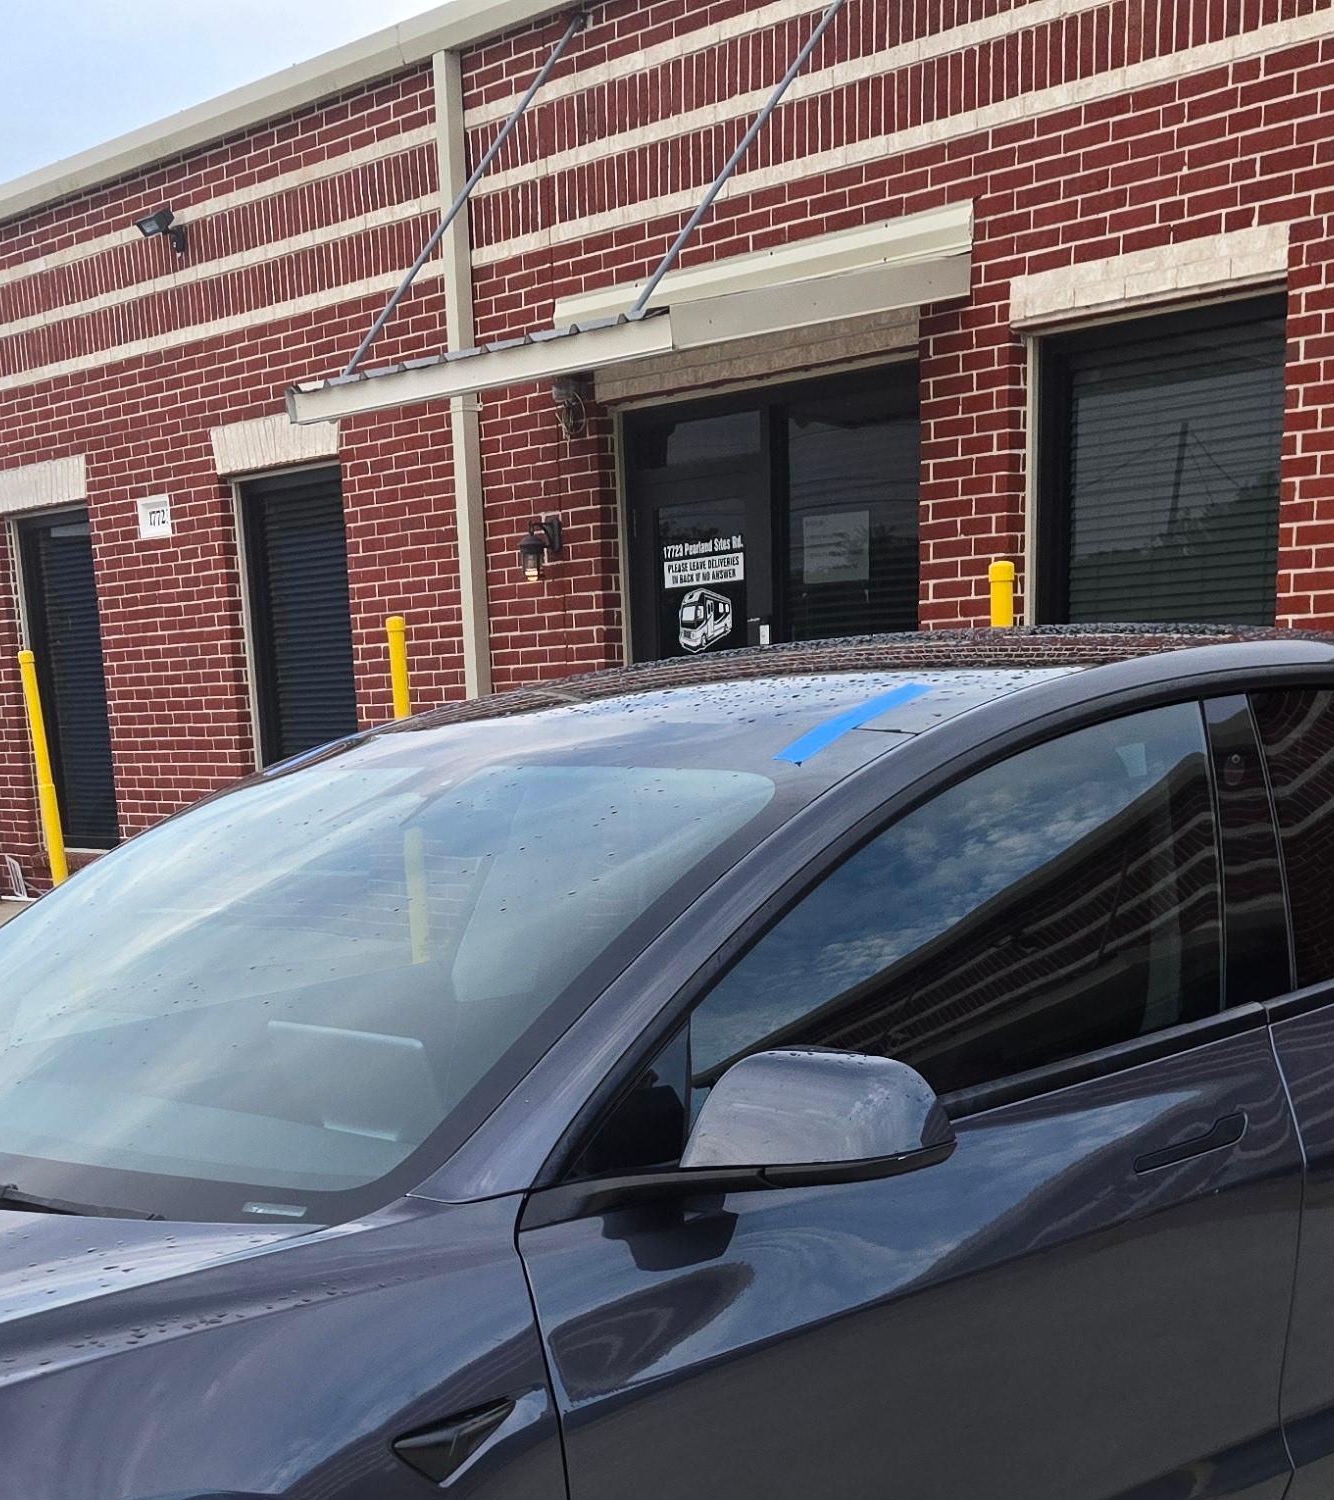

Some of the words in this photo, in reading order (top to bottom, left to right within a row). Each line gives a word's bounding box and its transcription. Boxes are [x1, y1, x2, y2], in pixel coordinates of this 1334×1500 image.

[149, 508, 168, 526] 1772
[663, 544, 684, 559] 17723
[684, 540, 713, 556] Pearland
[714, 538, 731, 552] Sites
[668, 562, 688, 574] PLEASE
[689, 560, 706, 571] LEAVE
[708, 556, 739, 569] DELIVERIES
[680, 573, 694, 584] BACK
[712, 569, 736, 580] ANSWER
